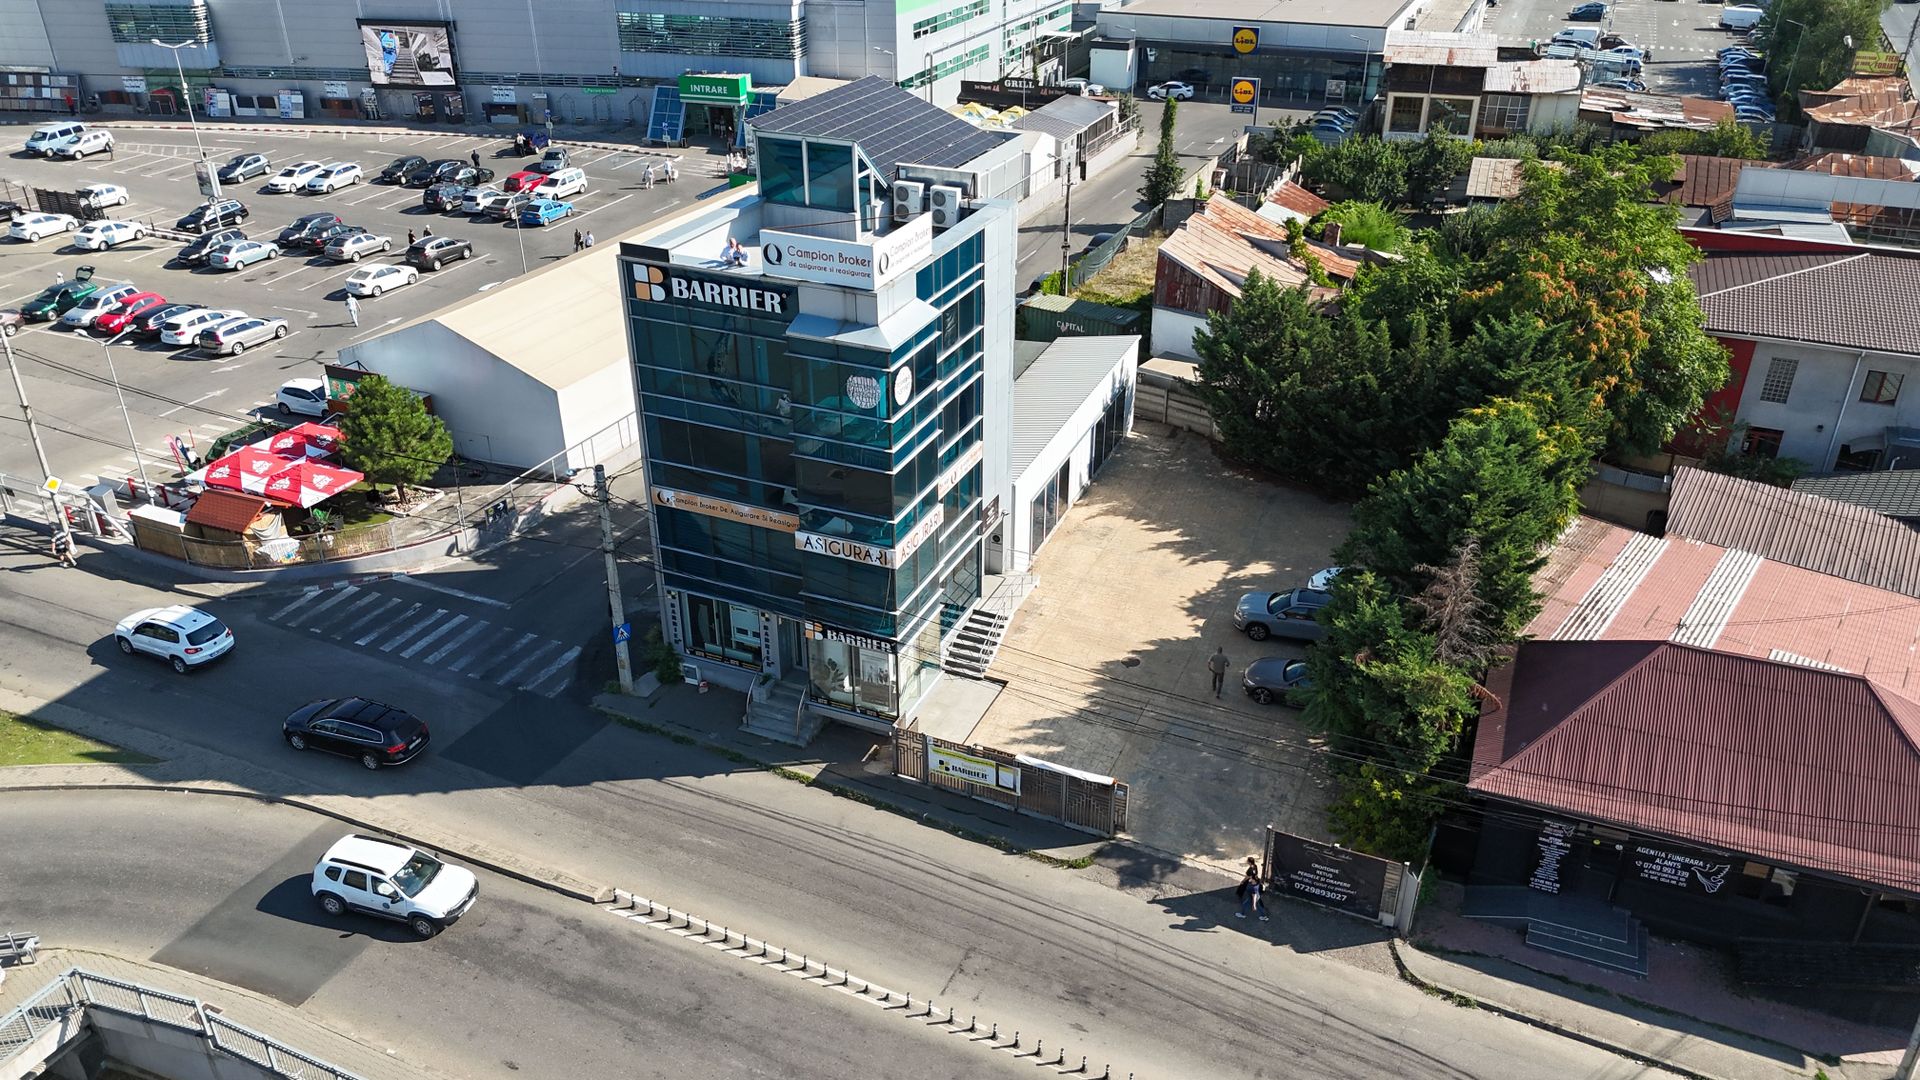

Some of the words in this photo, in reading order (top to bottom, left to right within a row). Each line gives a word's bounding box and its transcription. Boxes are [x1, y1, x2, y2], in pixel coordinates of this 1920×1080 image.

[690, 84, 728, 95] INTRARE
[1004, 79, 1034, 89] GRILL
[787, 245, 834, 262] Campion
[838, 252, 872, 268] Broker
[788, 260, 797, 268] de
[798, 263, 828, 272] asigurare
[829, 264, 835, 273] si
[835, 267, 872, 279] reasigurare
[671, 277, 783, 314] BARRIER
[1056, 320, 1085, 333] CAPITAL
[670, 495, 698, 507] Campion
[699, 501, 719, 512] Broker
[719, 505, 728, 513] De
[729, 508, 760, 521] Asigurare
[803, 535, 888, 566] ASIGURARI
[826, 629, 893, 652] BARRIER
[951, 765, 988, 780] BARRIER
[1636, 846, 1666, 859] AGENTIA
[1667, 853, 1704, 867] FUNERARA
[1654, 857, 1682, 869] ALANYS
[1643, 862, 1661, 872] 0749
[1294, 882, 1348, 901] 0729893027
